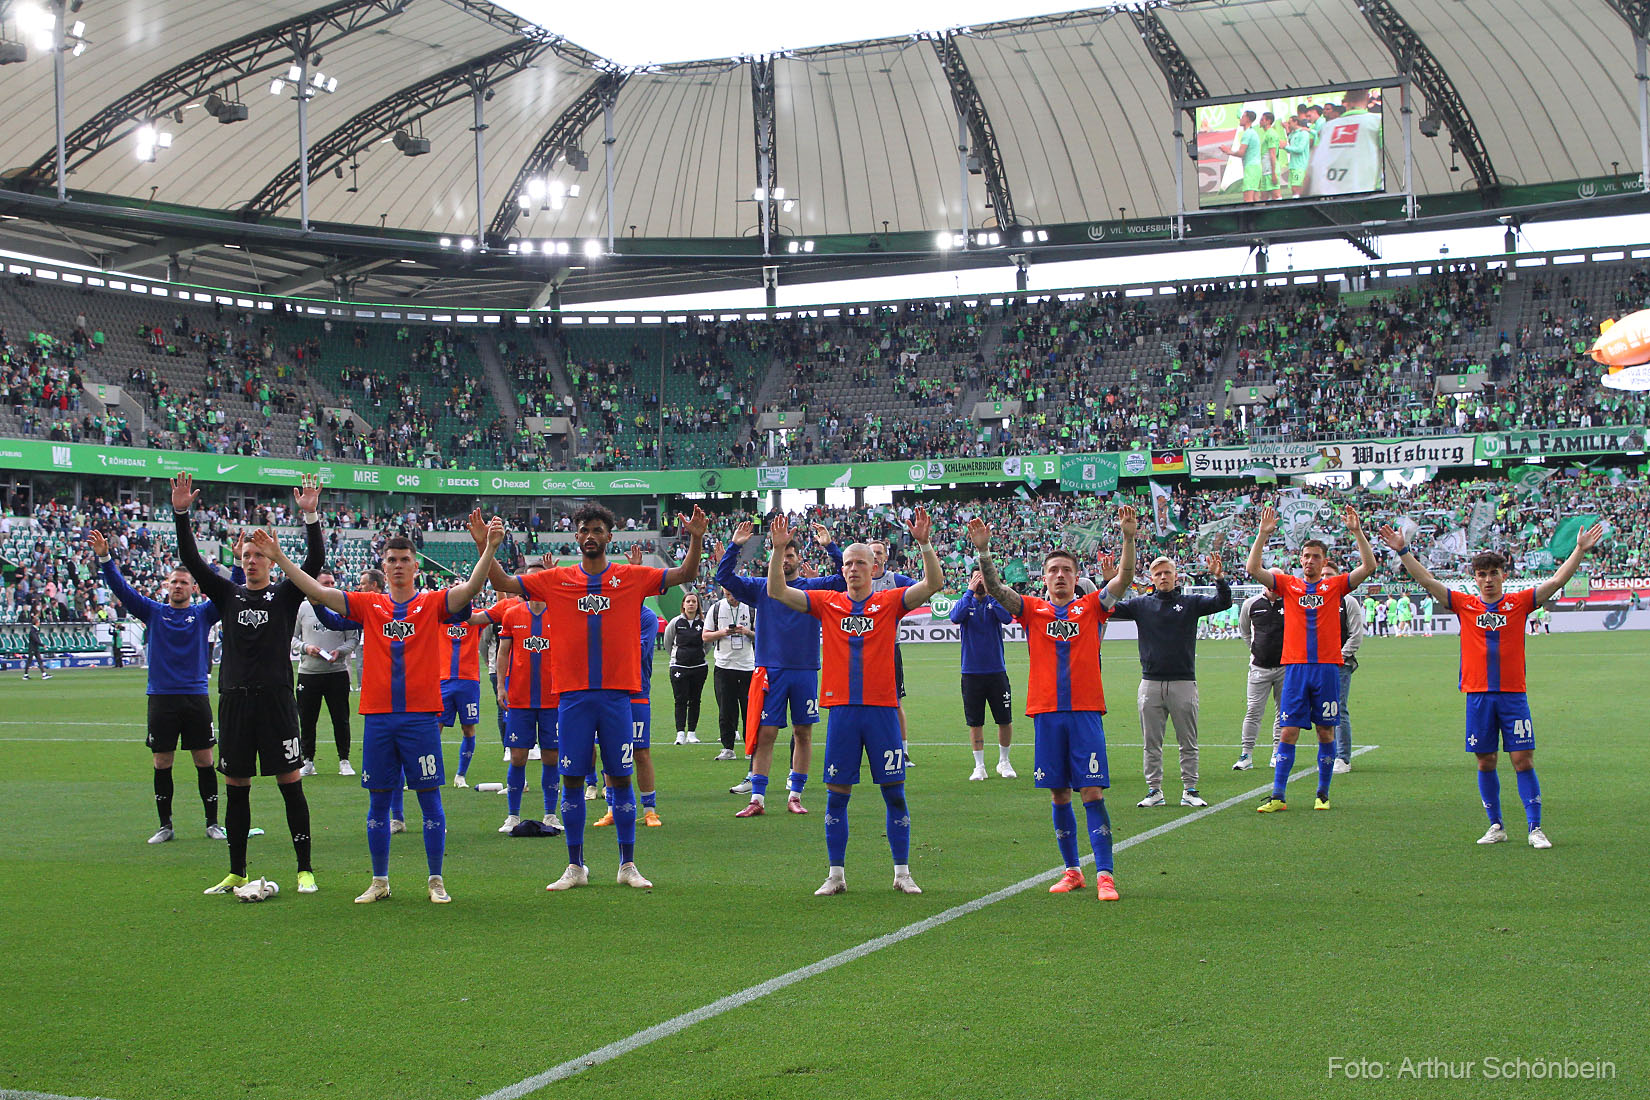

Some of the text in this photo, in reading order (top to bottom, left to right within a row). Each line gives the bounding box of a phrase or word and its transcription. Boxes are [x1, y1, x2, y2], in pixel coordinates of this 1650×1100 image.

[1327, 168, 1348, 182] 07
[109, 457, 146, 467] RÖHRDANZ
[1352, 443, 1464, 464] Wolfsburg
[1043, 461, 1055, 474] B
[354, 470, 379, 483] MRE
[397, 474, 420, 486] CHG
[503, 479, 530, 488] hexad
[466, 703, 478, 717] 15
[1322, 700, 1338, 717] 20
[632, 721, 645, 738] 17
[1514, 719, 1532, 738] 49
[283, 737, 300, 760] 30
[418, 754, 437, 777] 18
[884, 748, 903, 770] 27
[1089, 752, 1099, 774] 6
